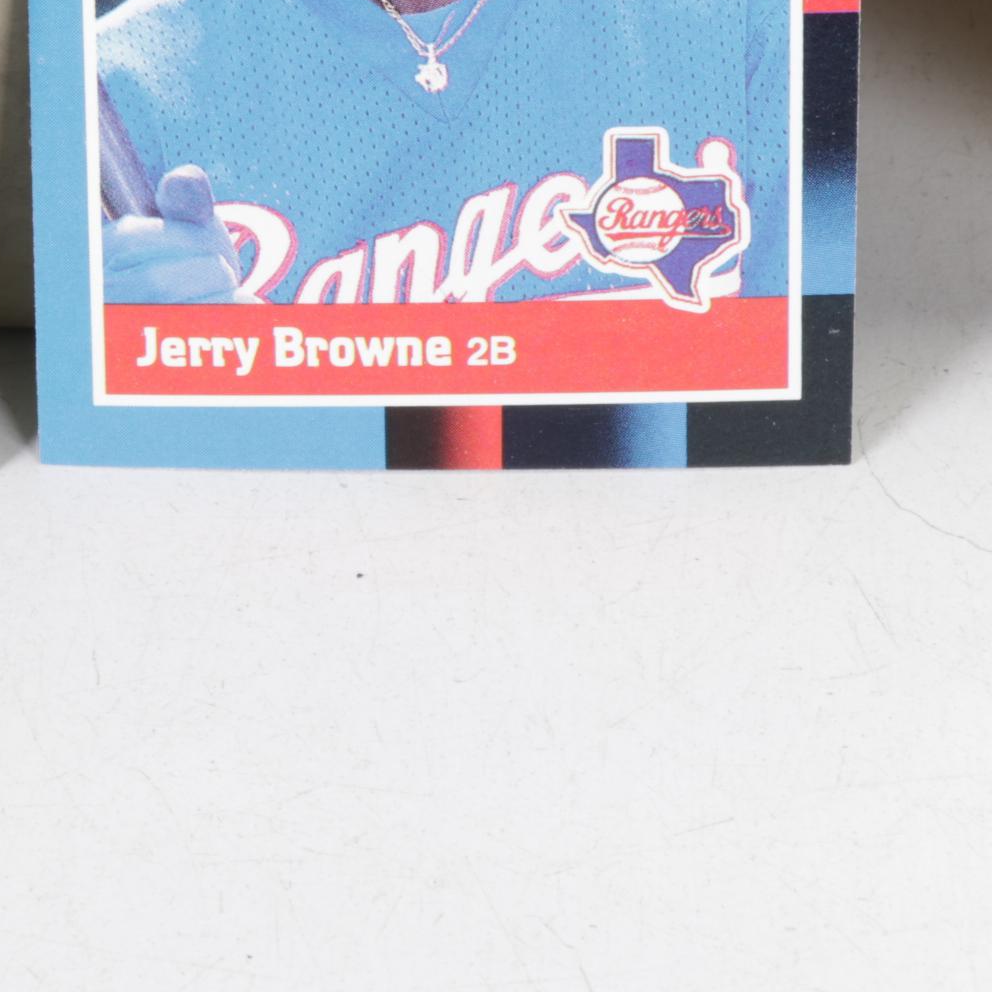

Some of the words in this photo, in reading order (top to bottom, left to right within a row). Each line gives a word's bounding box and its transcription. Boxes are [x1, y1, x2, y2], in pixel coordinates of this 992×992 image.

[598, 196, 732, 253] Rangers
[136, 326, 260, 377] Jerry
[272, 326, 453, 368] Browne
[467, 335, 518, 367] 2B
